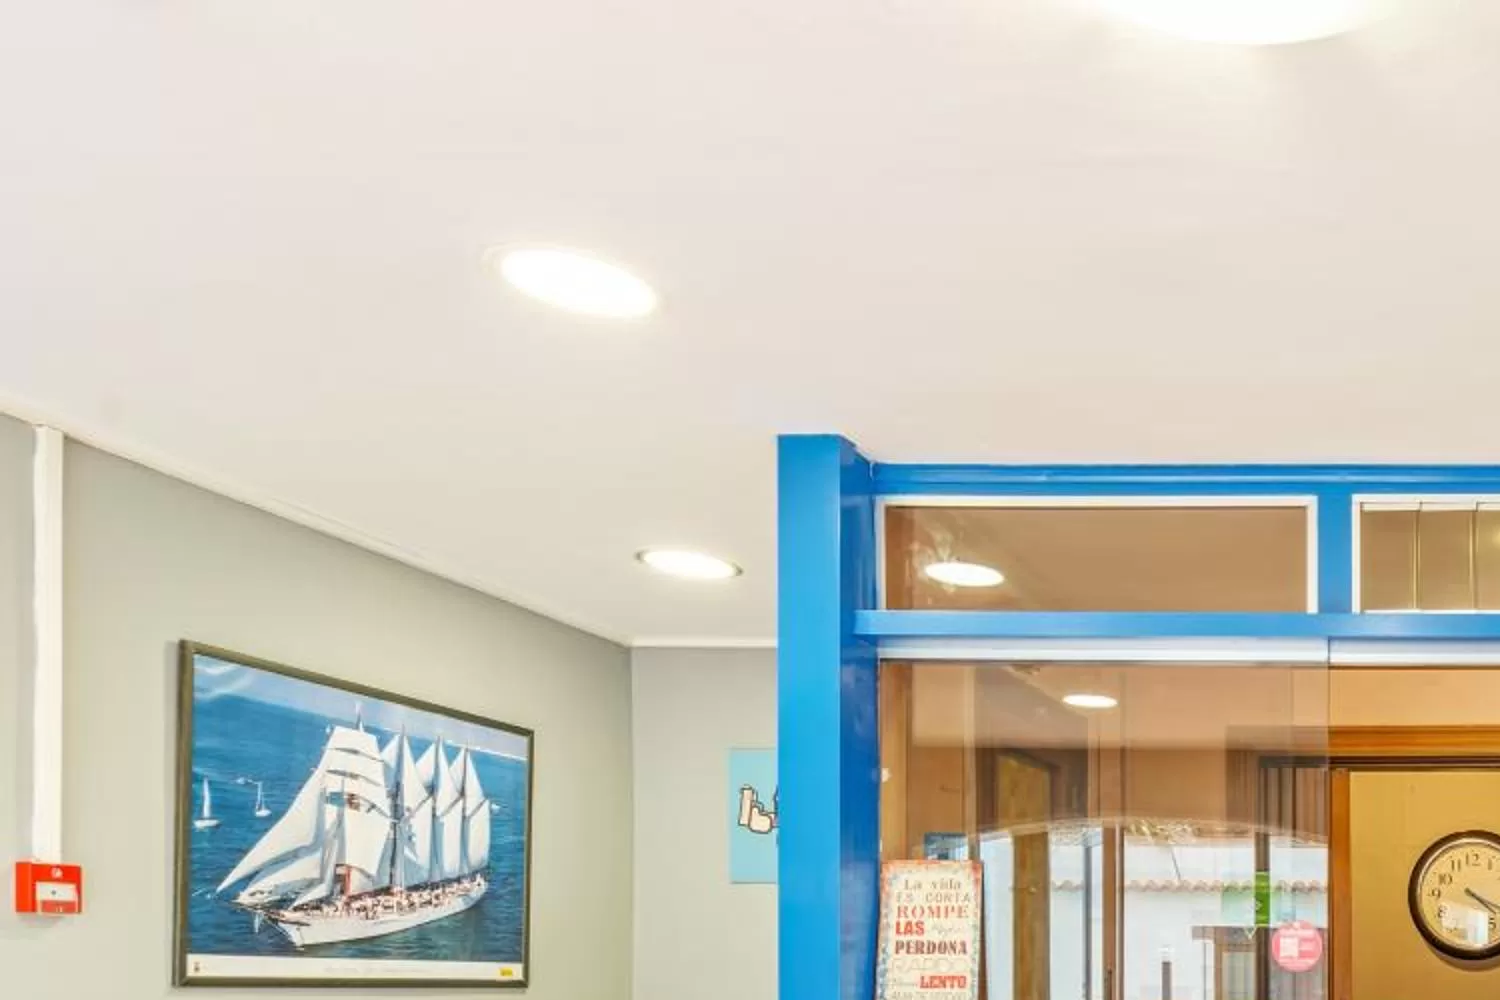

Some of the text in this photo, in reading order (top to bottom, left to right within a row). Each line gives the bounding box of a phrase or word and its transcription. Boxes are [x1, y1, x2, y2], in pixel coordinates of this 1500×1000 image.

[1451, 859, 1461, 872] 11
[1465, 853, 1480, 866] 12
[904, 878, 961, 890] La vida
[897, 905, 969, 918] ROMPE
[895, 920, 925, 936] LAS
[894, 940, 967, 955] PERDONA
[919, 975, 967, 989] LENTO
